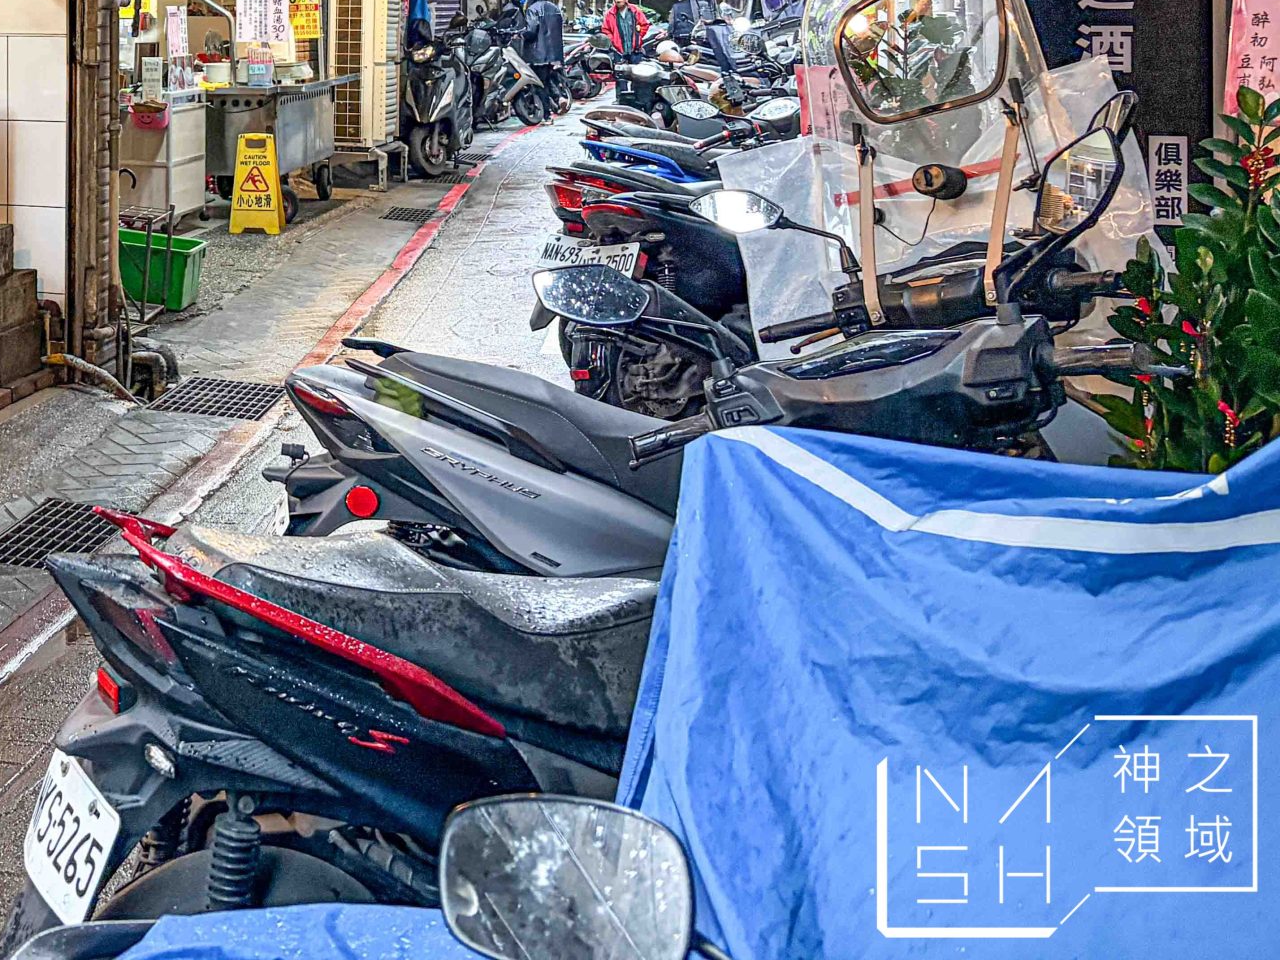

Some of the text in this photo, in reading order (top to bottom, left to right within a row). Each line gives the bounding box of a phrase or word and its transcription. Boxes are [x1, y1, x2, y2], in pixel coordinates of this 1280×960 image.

[1154, 142, 1182, 220] 俱樂部
[236, 194, 272, 208] 小心地滑
[541, 242, 584, 266] NAN-693
